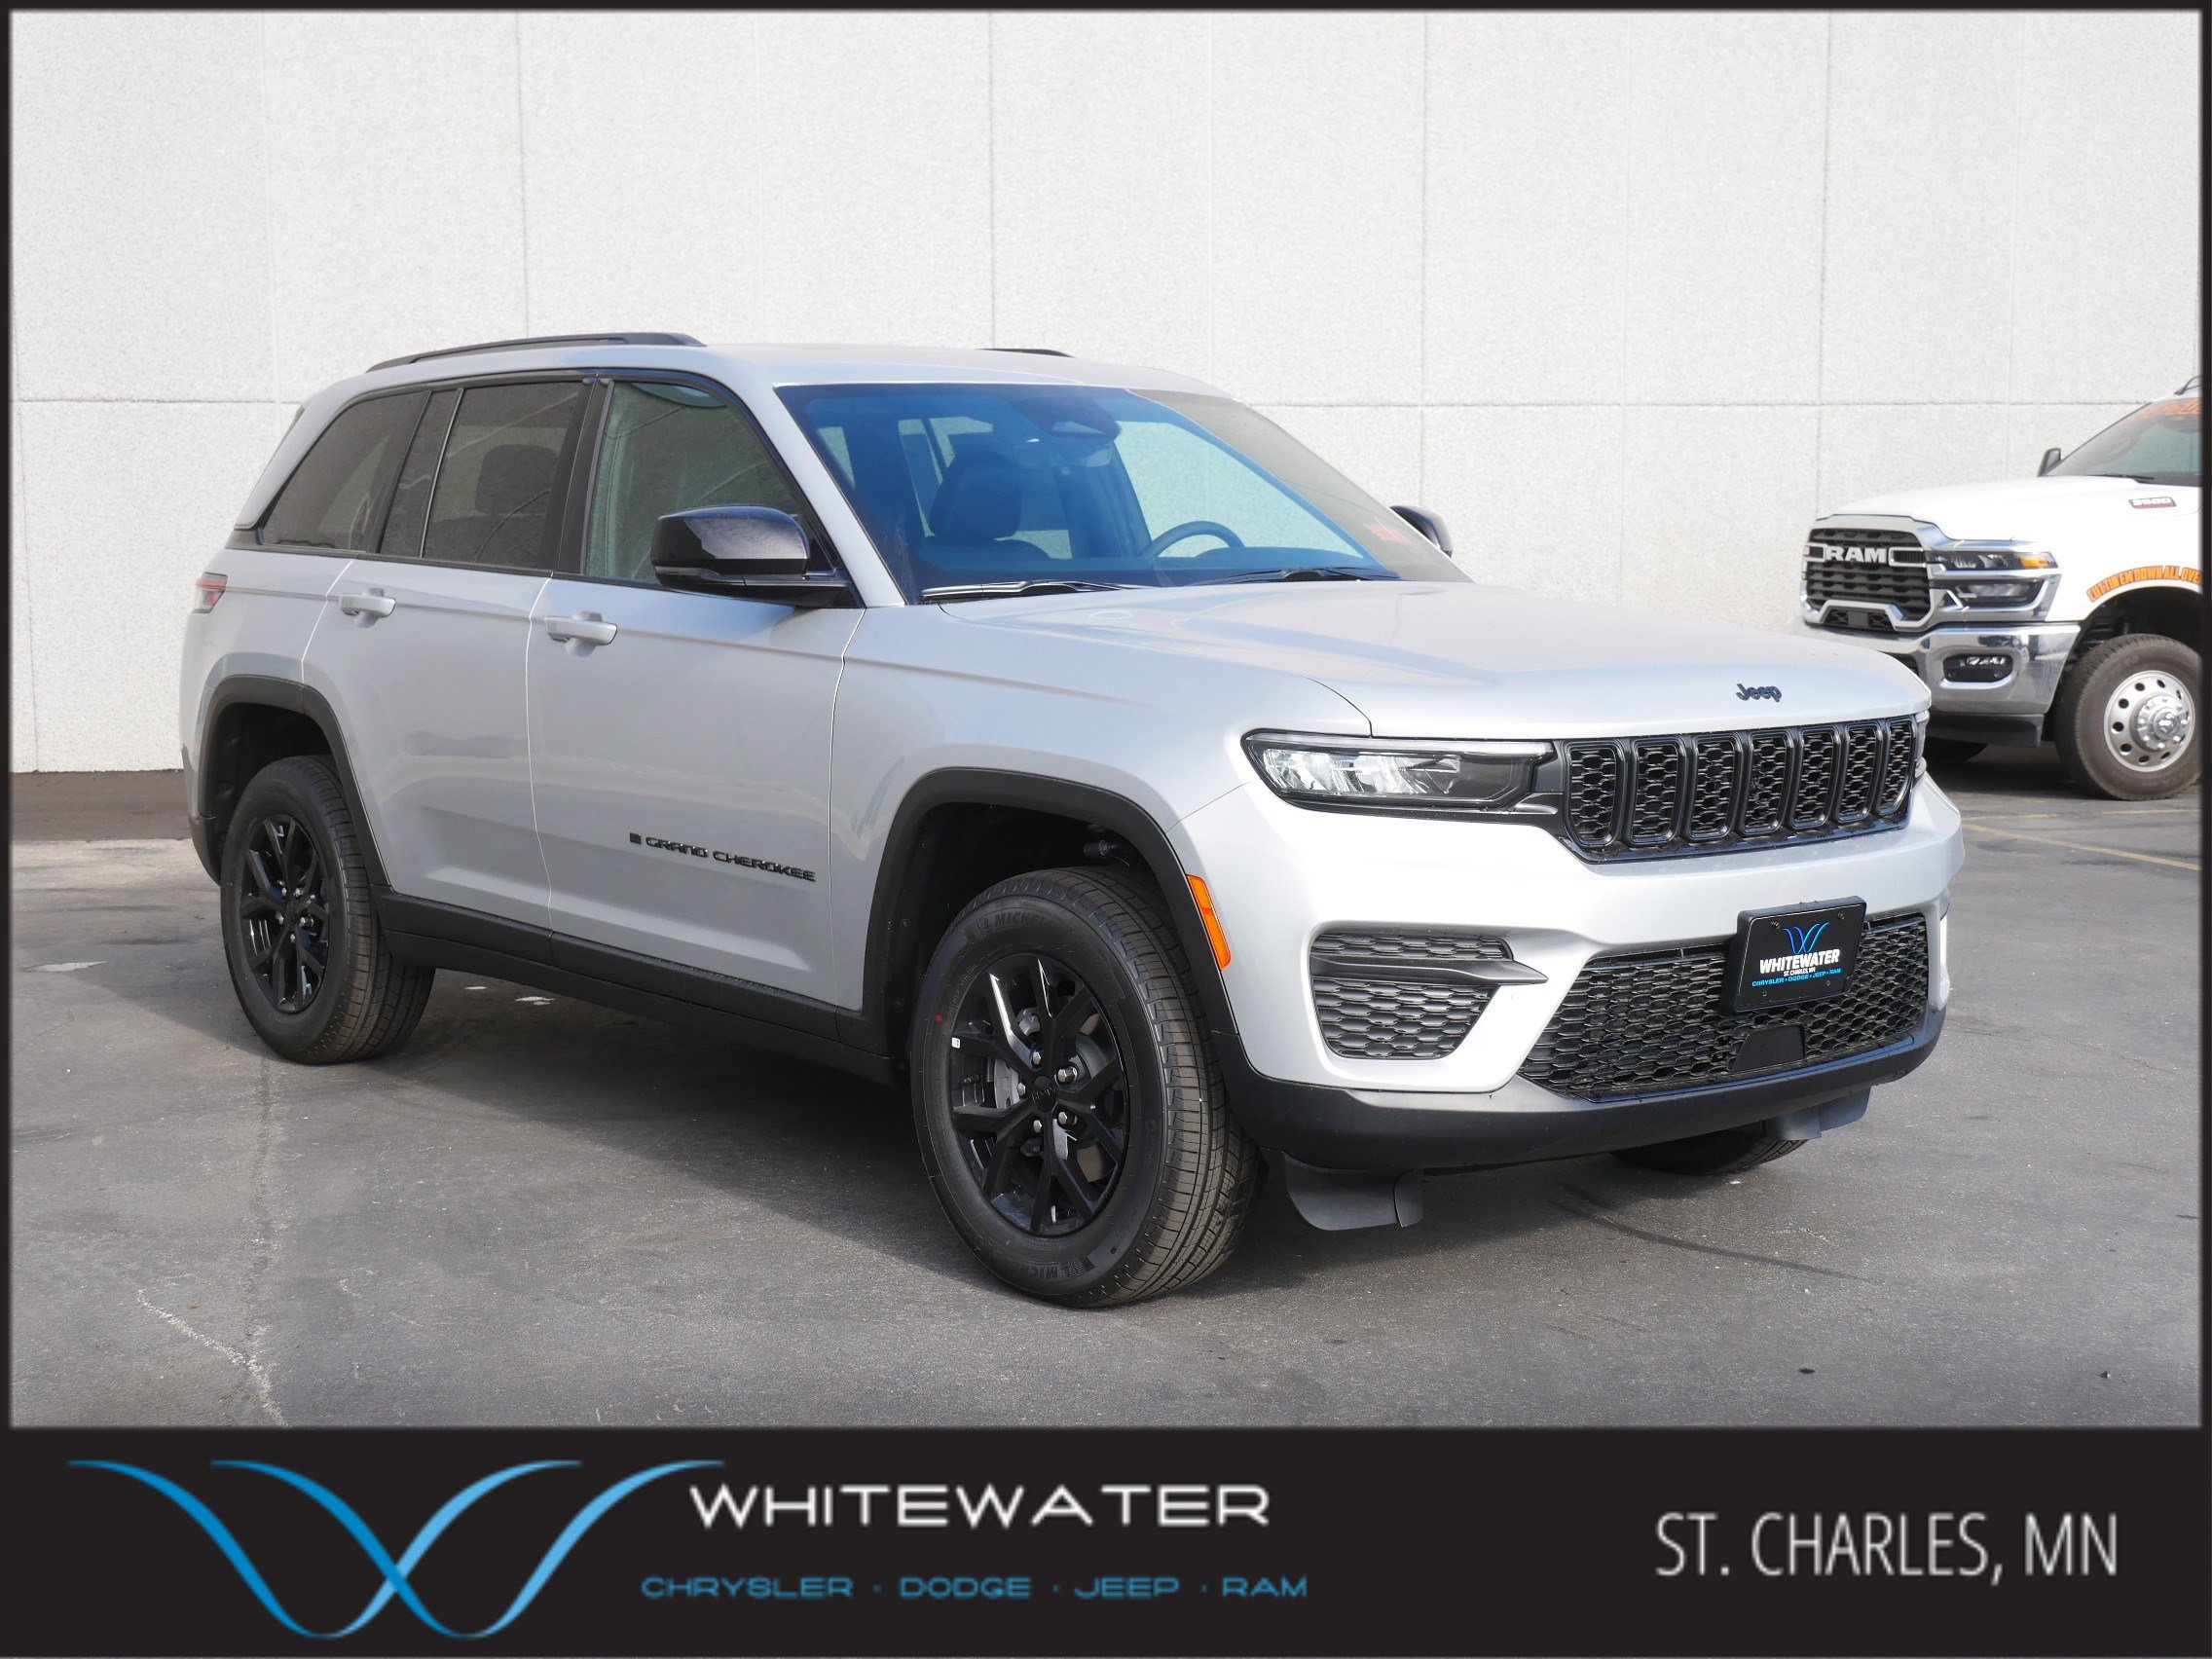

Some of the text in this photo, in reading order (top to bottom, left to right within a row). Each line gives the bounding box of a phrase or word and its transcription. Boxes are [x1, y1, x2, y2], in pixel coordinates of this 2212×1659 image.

[1825, 546, 1887, 563] RAM
[2133, 565, 2163, 581] DOWN
[2163, 565, 2180, 580] ALL
[1736, 683, 1782, 702] Jeep
[645, 836, 817, 882] GRAND CHEROKEE
[1759, 949, 1840, 974] WHITEWATER
[1751, 977, 1784, 987] CHRYSLER
